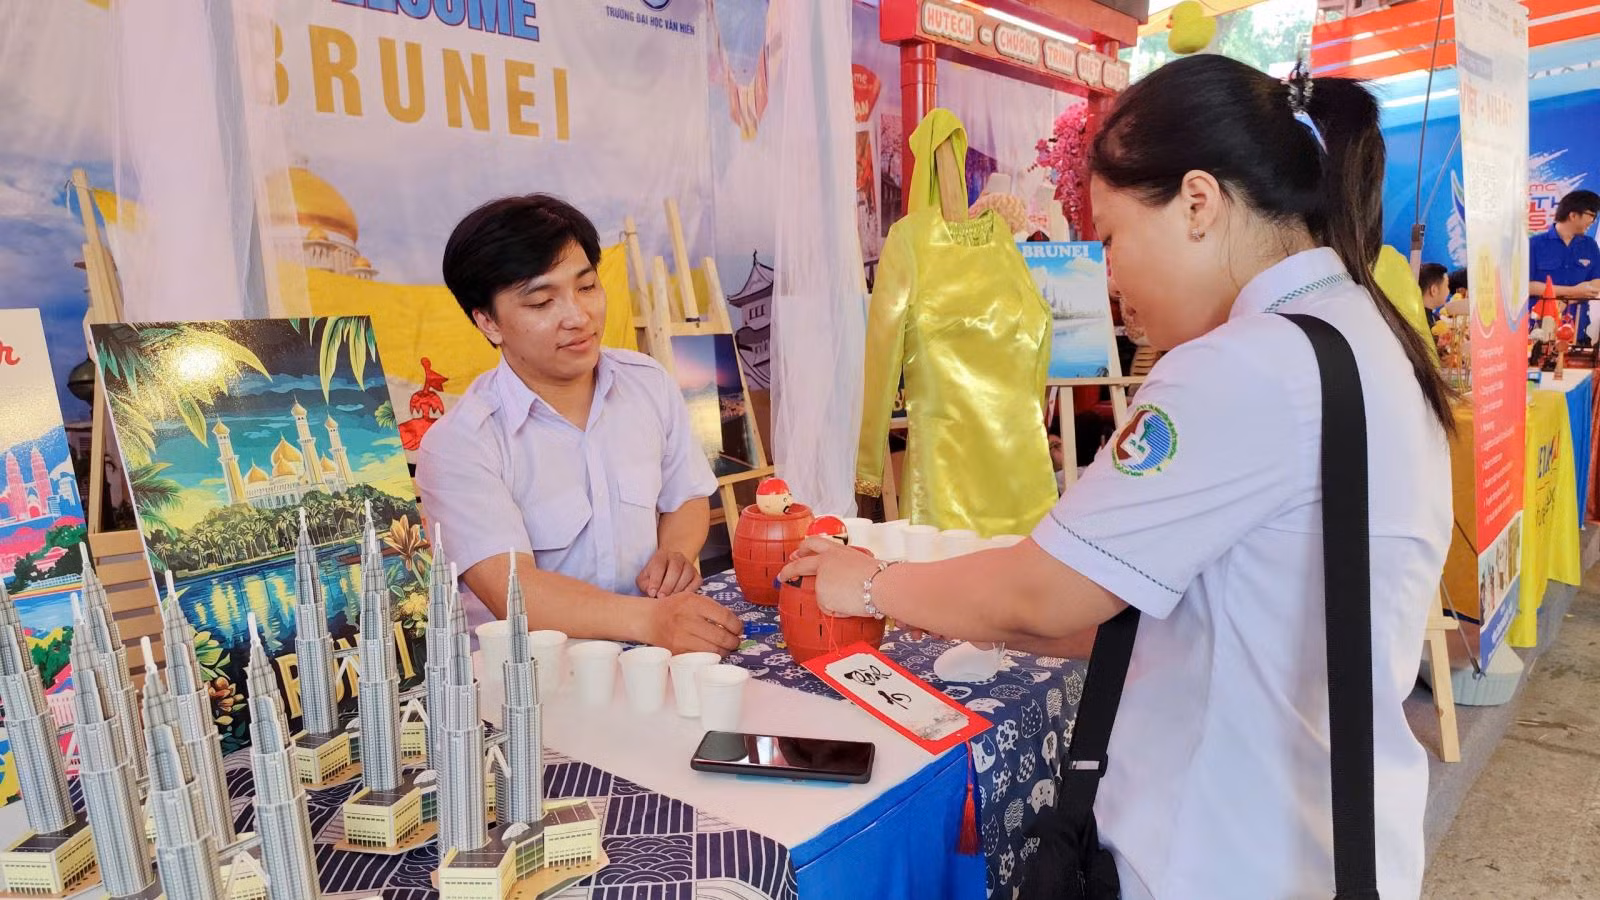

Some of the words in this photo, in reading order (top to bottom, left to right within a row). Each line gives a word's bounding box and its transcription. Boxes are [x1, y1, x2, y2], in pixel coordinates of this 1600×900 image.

[649, 16, 663, 30] HỌC
[665, 18, 679, 33] VĂN
[926, 6, 973, 41] HUTECH
[1022, 244, 1088, 259] BRUNEI
